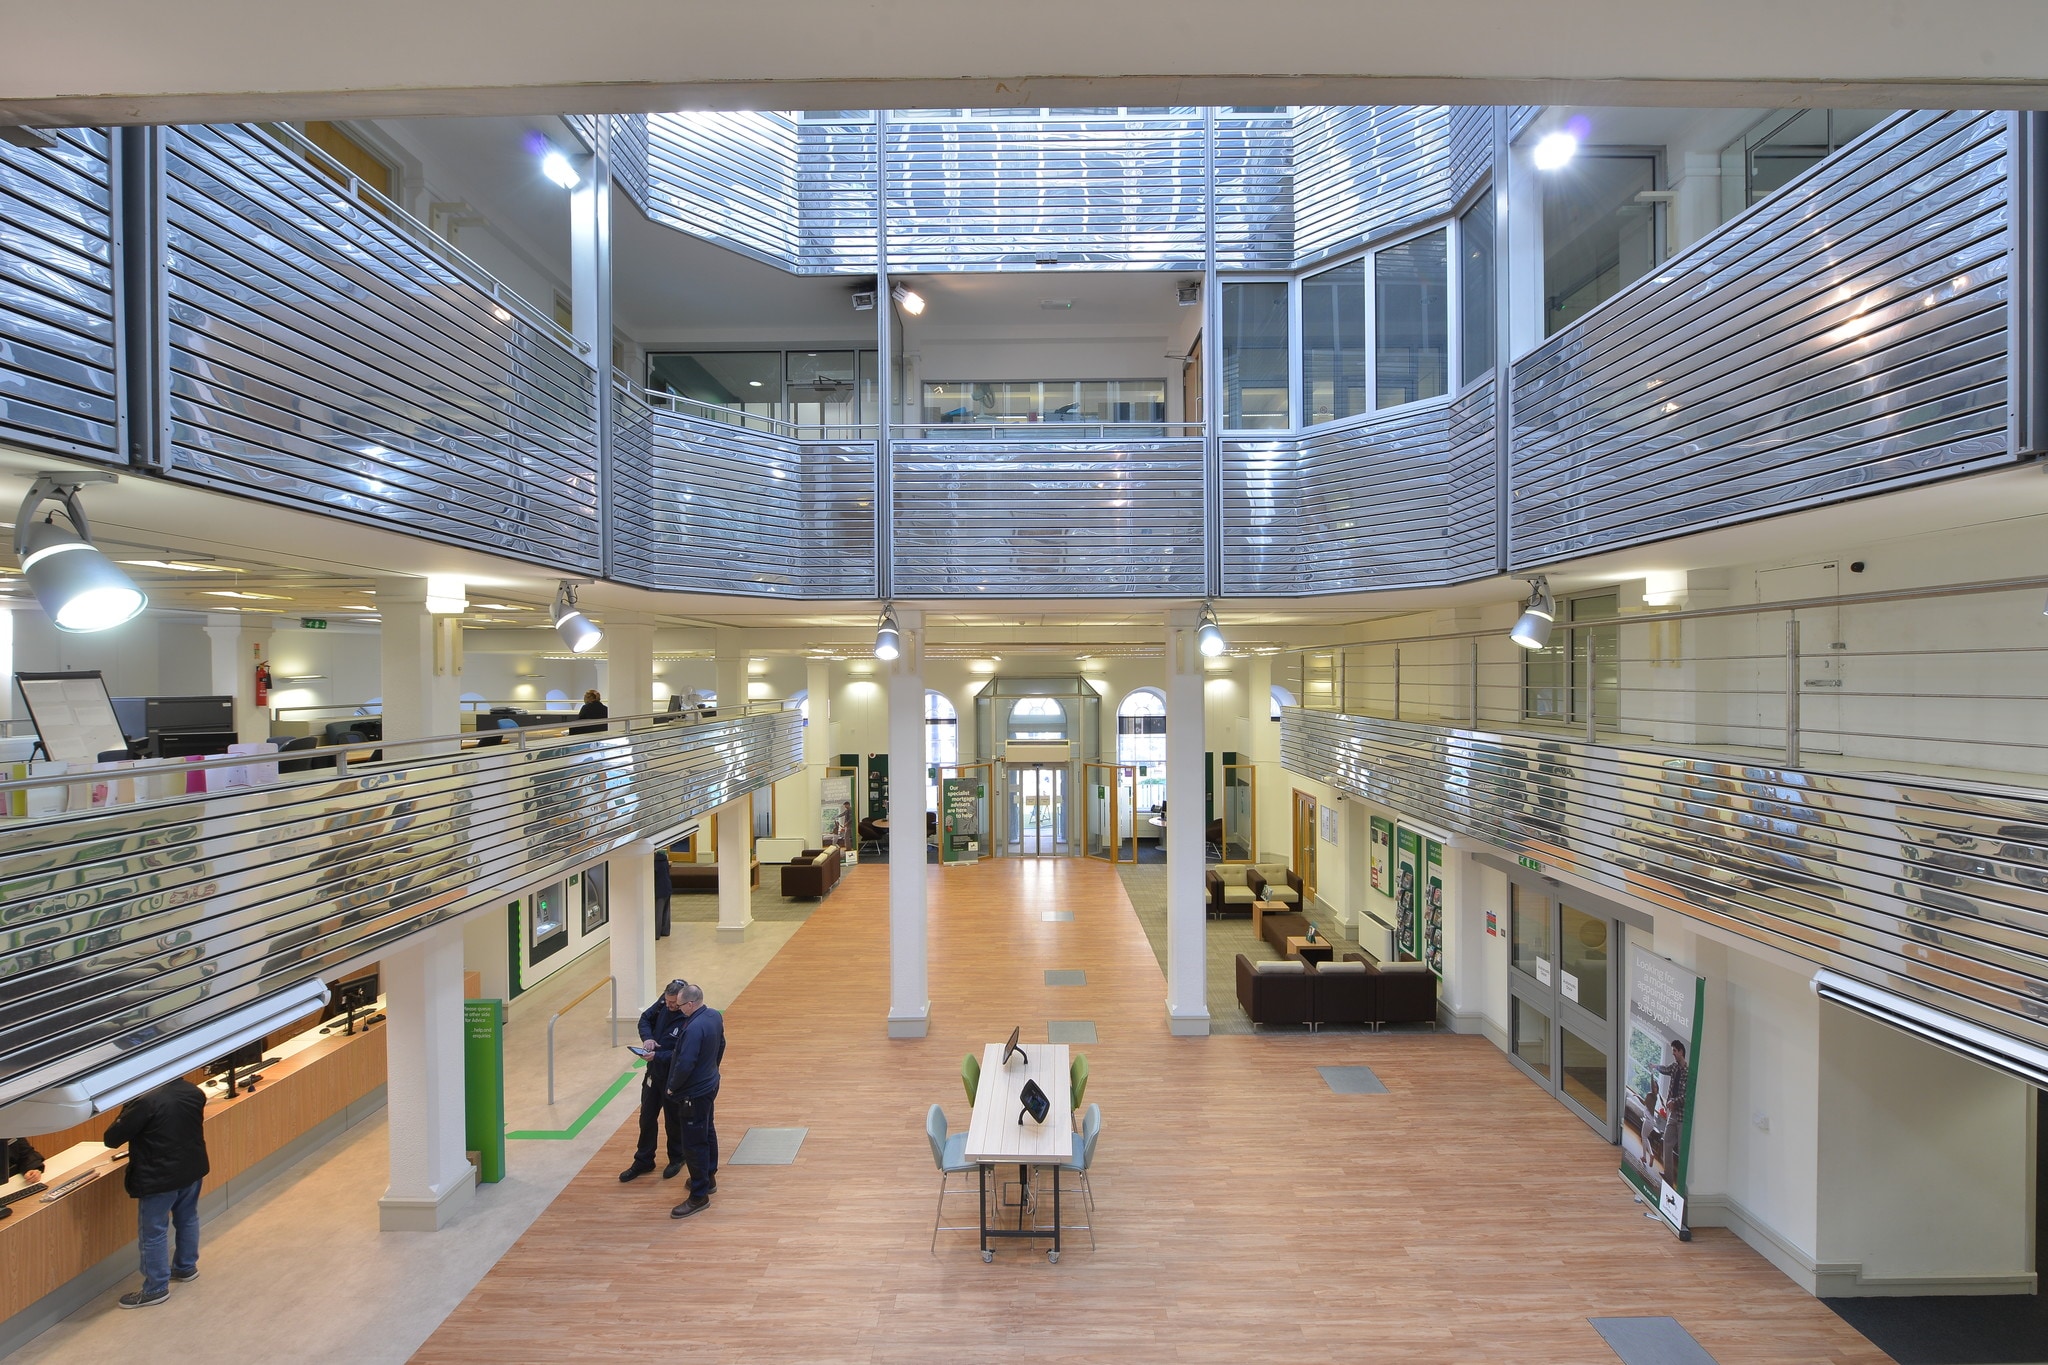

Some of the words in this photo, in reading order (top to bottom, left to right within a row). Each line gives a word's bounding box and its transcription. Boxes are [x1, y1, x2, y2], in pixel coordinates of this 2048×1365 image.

[1636, 956, 1664, 980] Looking
[1664, 971, 1674, 984] for
[1637, 981, 1682, 1012] appointment
[1650, 976, 1684, 1002] mortgage
[1637, 1002, 1652, 1016] suits
[1653, 1012, 1670, 1026] you?
[1642, 994, 1650, 1004] at
[1656, 999, 1672, 1017] time
[1673, 1011, 1688, 1028] that
